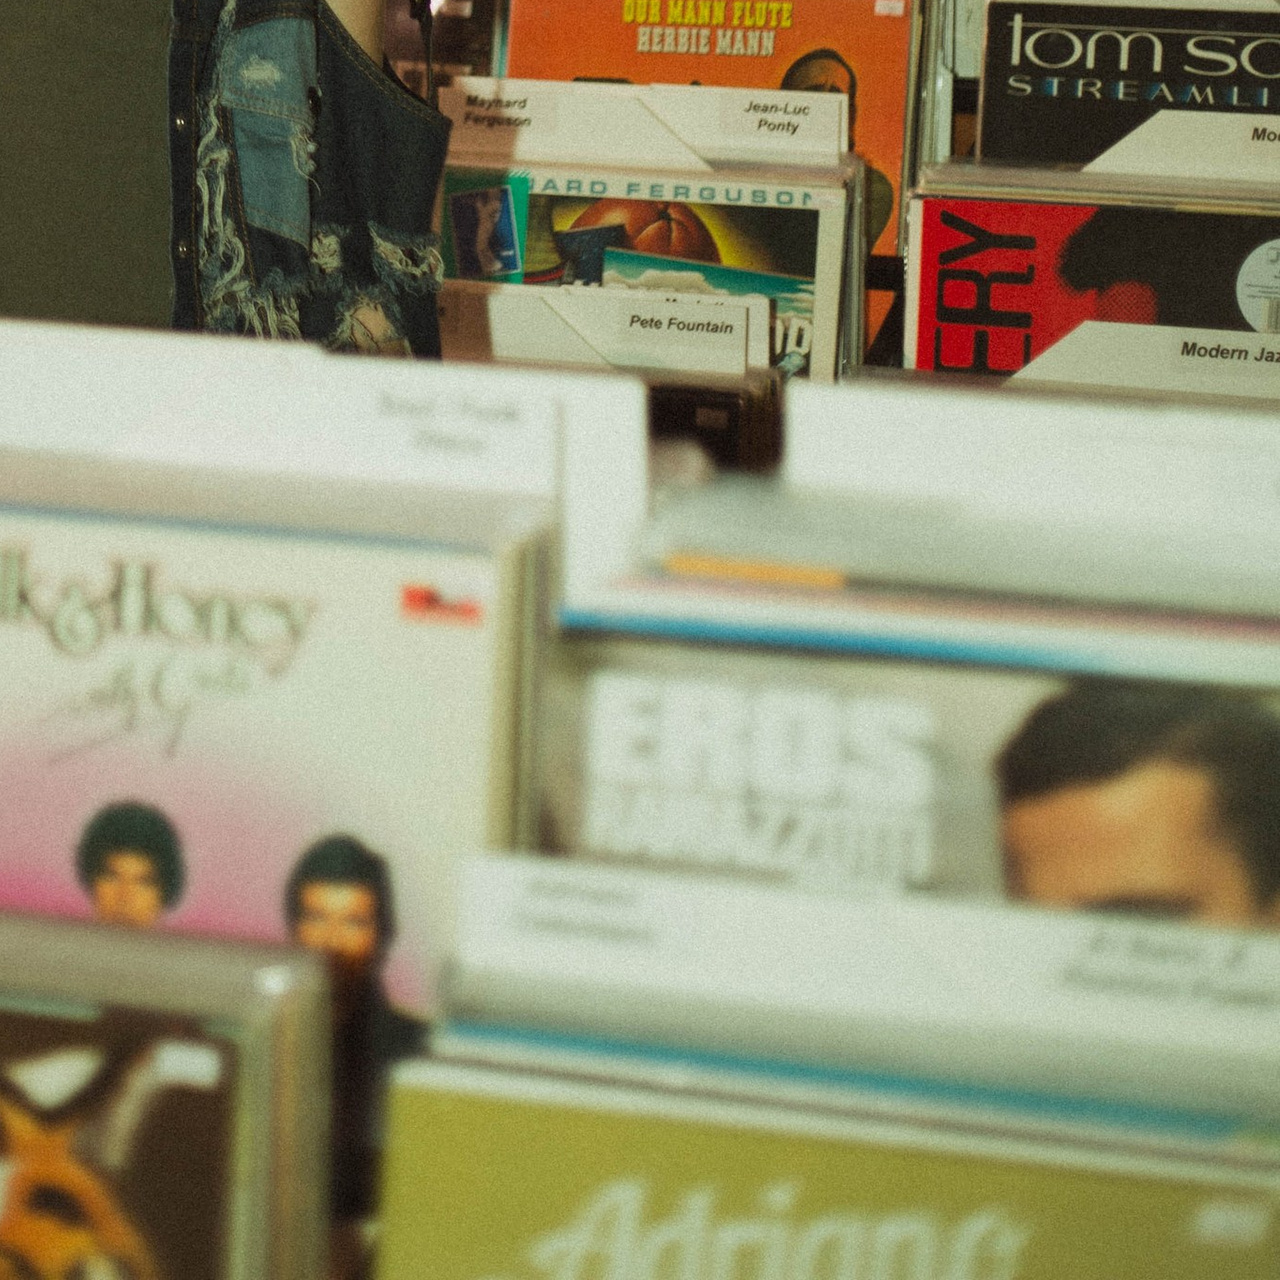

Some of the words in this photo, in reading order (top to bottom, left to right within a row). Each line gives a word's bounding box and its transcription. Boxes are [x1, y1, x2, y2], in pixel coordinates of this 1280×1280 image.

[732, 0, 793, 28] FLUTE
[636, 26, 711, 55] HERBIE
[715, 29, 776, 56] MANN
[465, 94, 528, 112] Maynard
[744, 99, 810, 117] Jean-Luc
[463, 112, 531, 129] Ferguson
[757, 118, 799, 136] Ponty
[629, 314, 662, 330] Pete
[667, 317, 734, 335] Fountain
[1181, 341, 1249, 361] Modern
